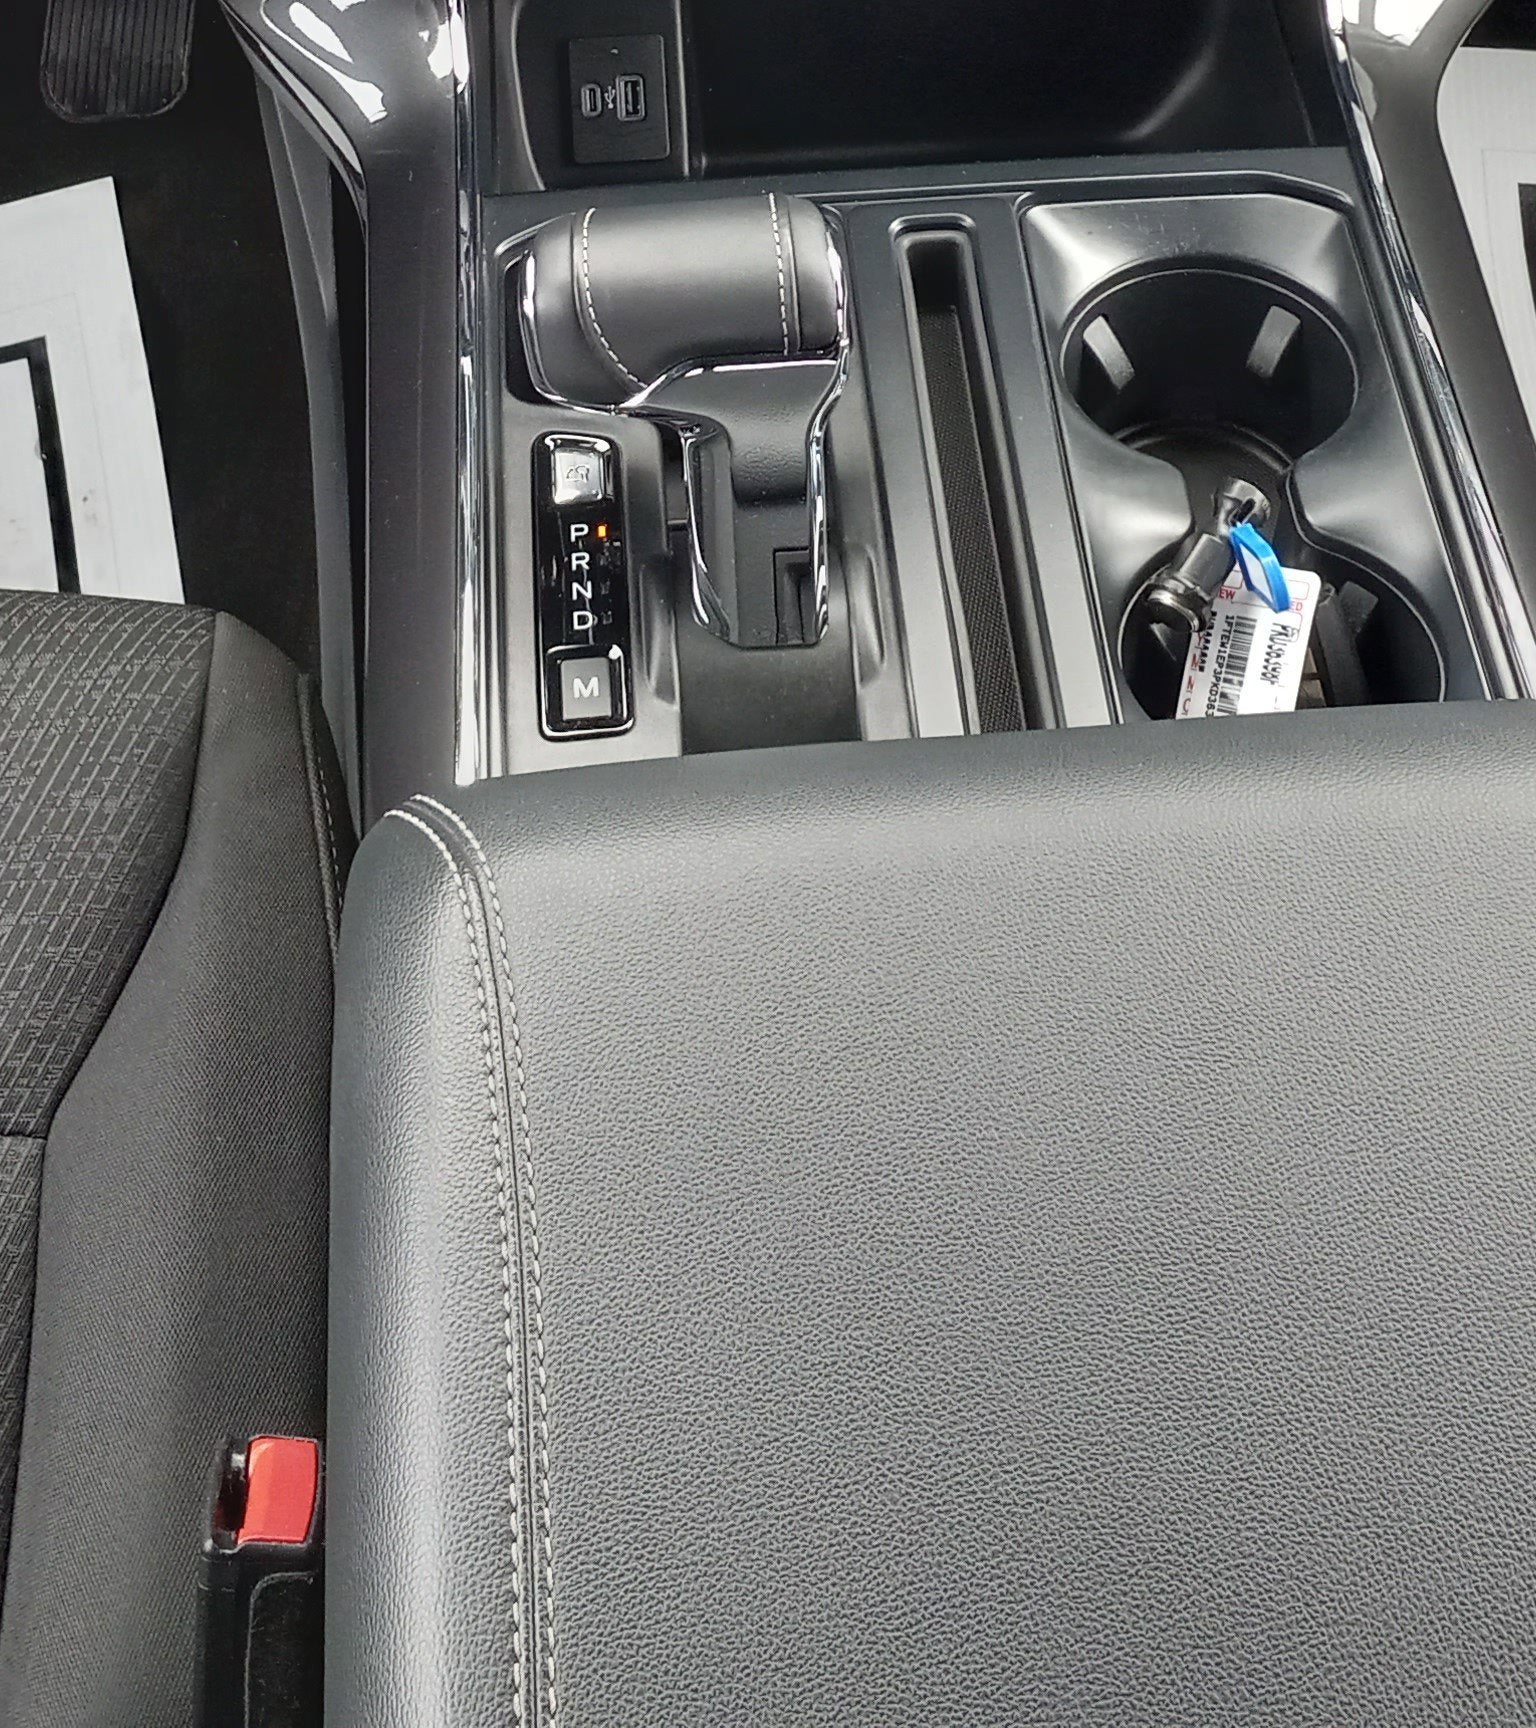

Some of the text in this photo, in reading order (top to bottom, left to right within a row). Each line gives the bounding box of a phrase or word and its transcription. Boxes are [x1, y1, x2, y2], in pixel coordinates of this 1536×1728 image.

[569, 523, 590, 543] P
[570, 552, 591, 572] R
[571, 581, 593, 601] N
[1219, 587, 1237, 601] EW
[572, 611, 594, 631] D
[572, 676, 600, 699] M
